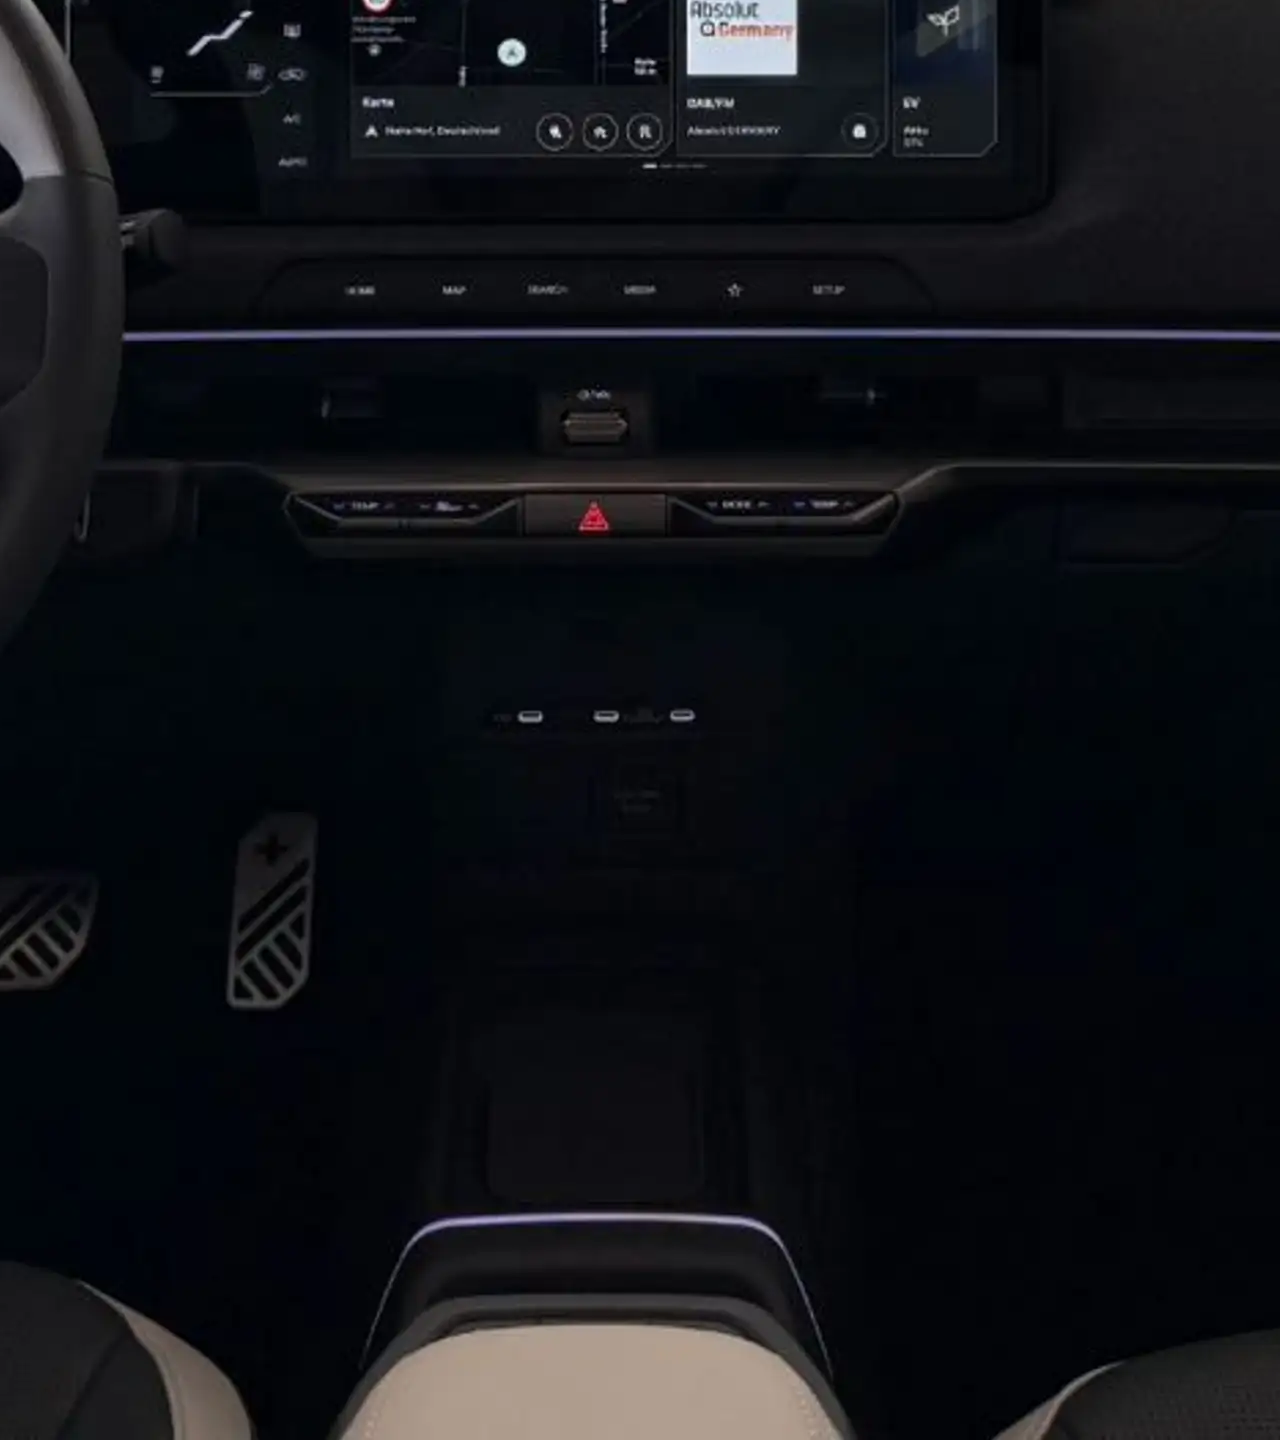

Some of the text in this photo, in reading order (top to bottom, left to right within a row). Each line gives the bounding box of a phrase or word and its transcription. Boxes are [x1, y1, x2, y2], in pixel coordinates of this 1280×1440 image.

[690, 1, 759, 20] Absolut
[718, 23, 794, 42] Germany
[441, 284, 468, 296] MAP
[811, 283, 847, 296] SETUP
